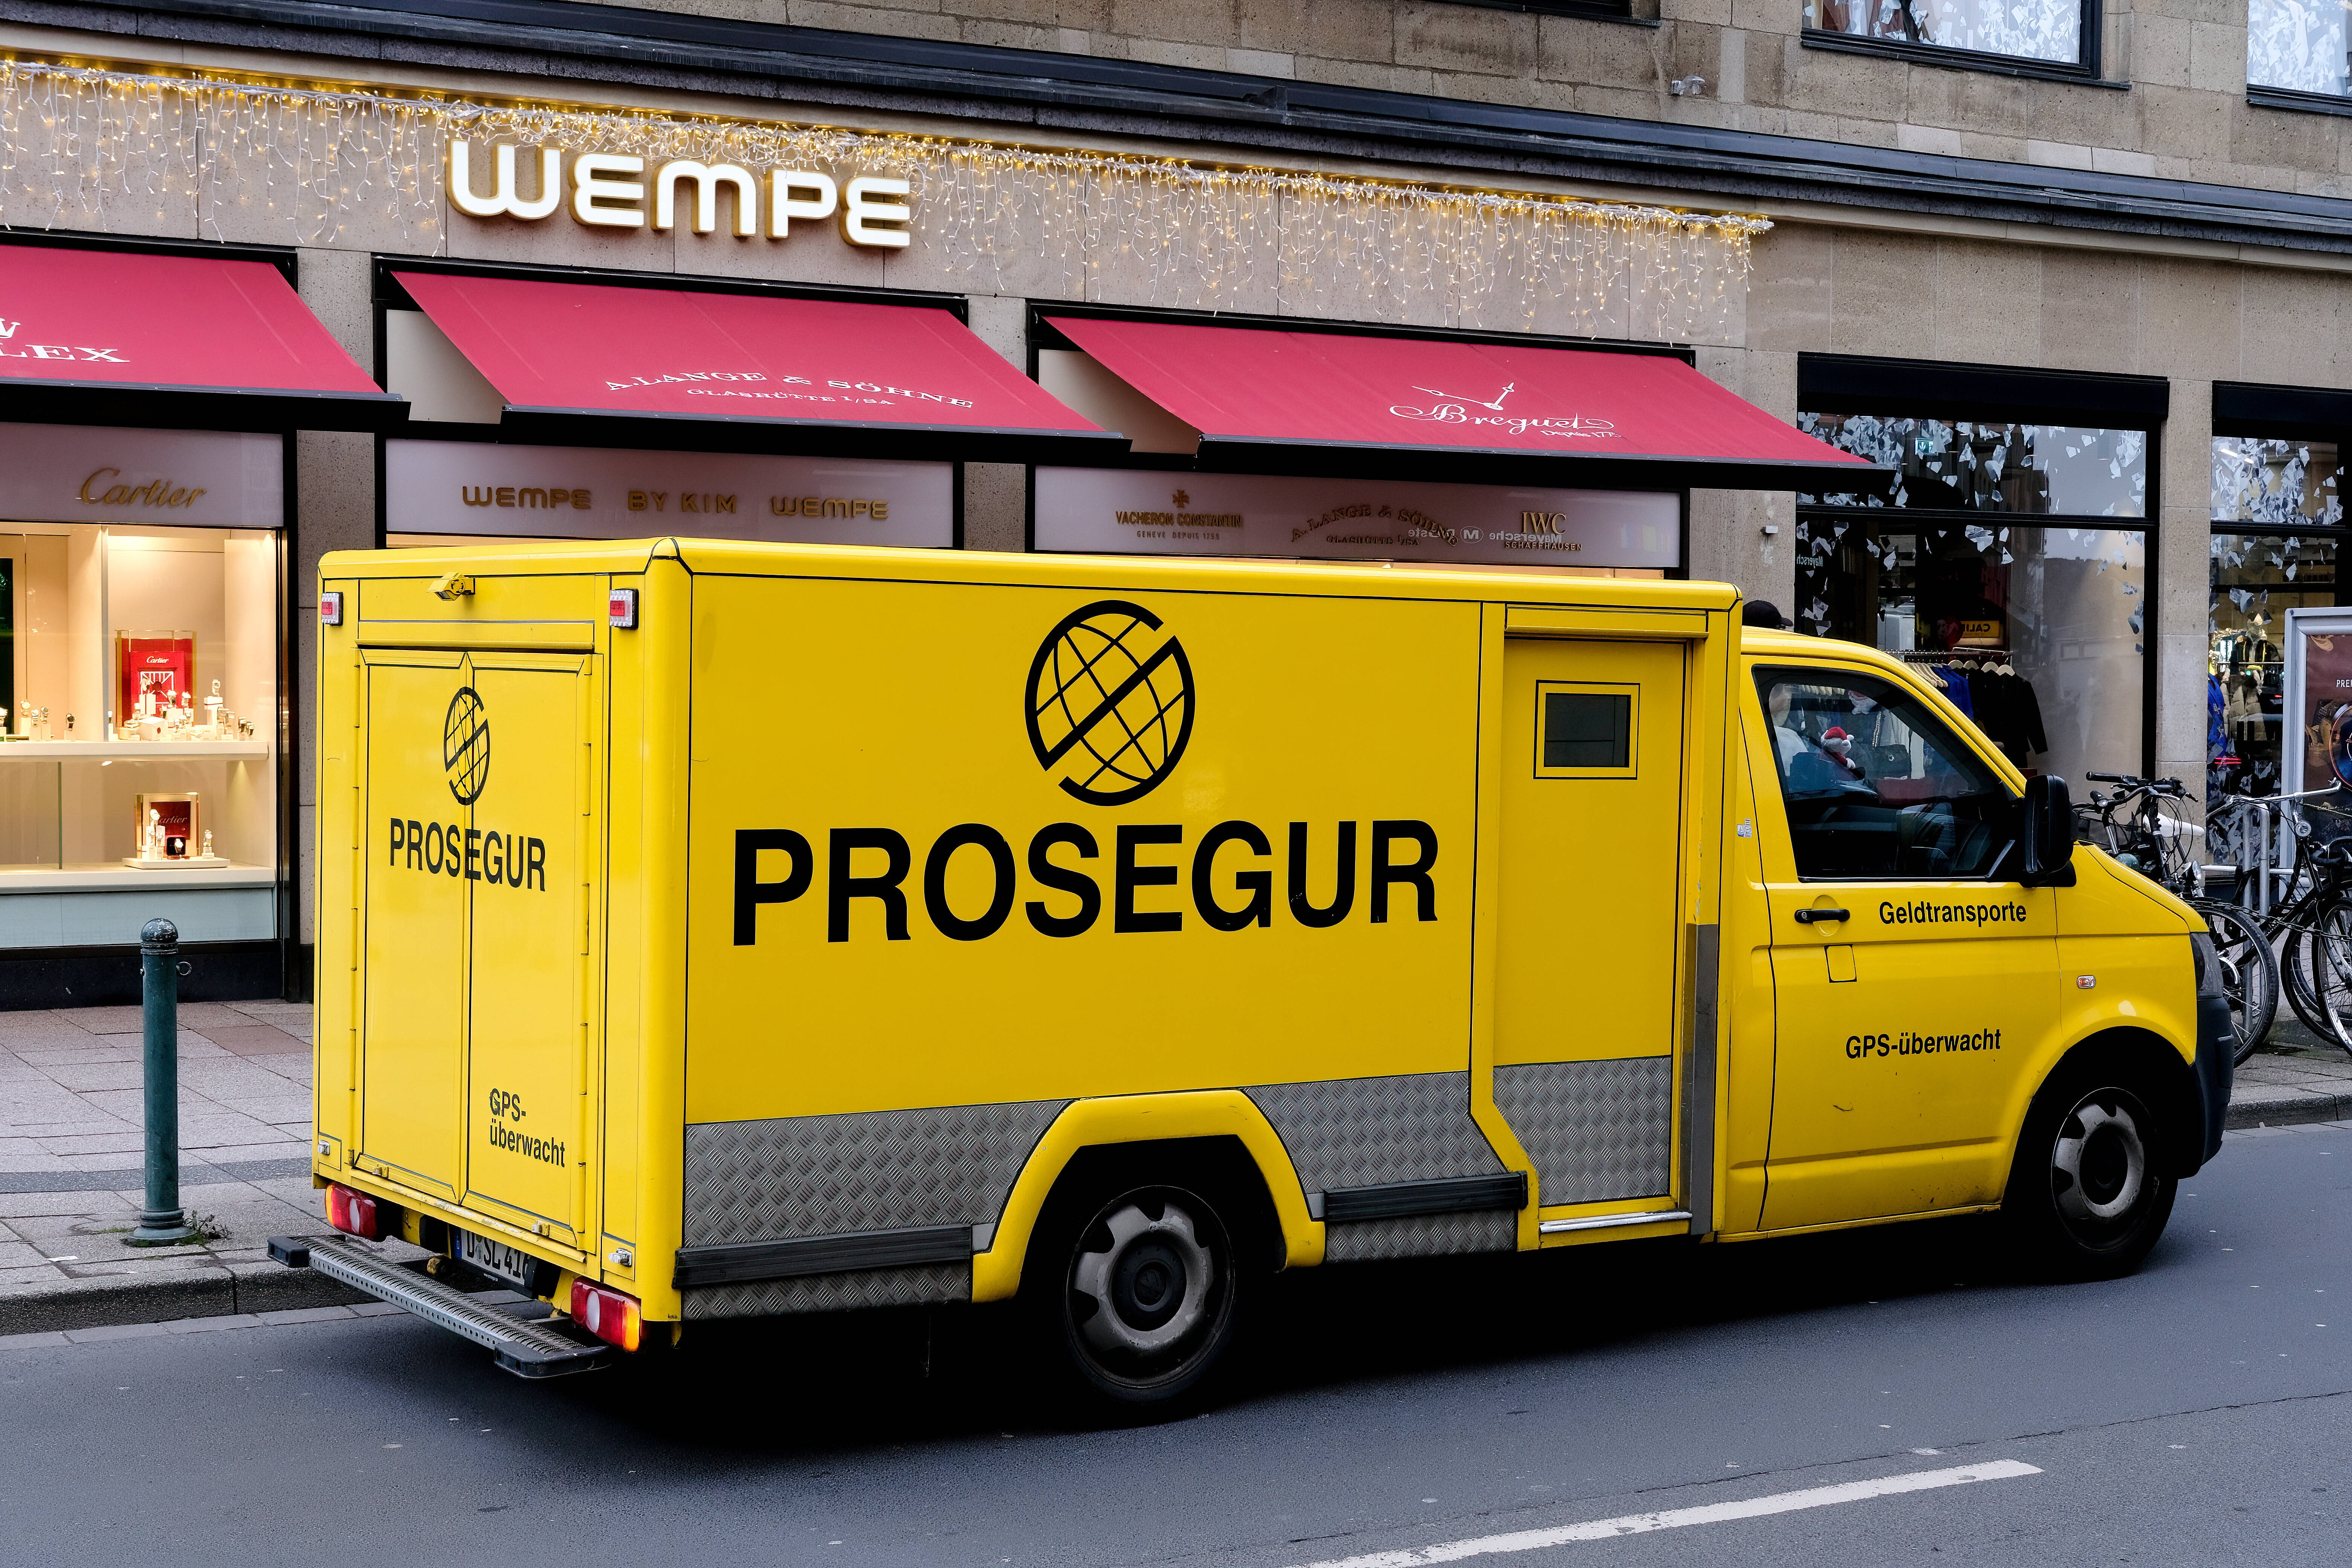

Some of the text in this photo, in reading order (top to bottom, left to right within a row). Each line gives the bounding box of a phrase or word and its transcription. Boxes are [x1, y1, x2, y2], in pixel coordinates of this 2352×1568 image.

[447, 139, 910, 248] WEMPE
[687, 389, 836, 402] GLASHÜTTE
[782, 375, 812, 385] &
[827, 380, 973, 408] SÖHNE
[1389, 403, 1614, 435] Breguet
[81, 467, 207, 508] Cartier
[462, 485, 890, 519] WEMPE BY KIM WEMPE
[1116, 510, 1243, 528] VACHERON CONSTANTIN
[1521, 512, 1567, 535] IWC
[1505, 541, 1583, 551] SCHAFFHAUSEN
[390, 818, 545, 892] PROSEGUR
[733, 819, 1438, 946] PROSEGUR
[1879, 901, 2027, 928] Geldtransporte
[1846, 1028, 2001, 1059] GPS-überwacht
[489, 1088, 526, 1122] GPS-
[490, 1118, 565, 1168] überwacht
